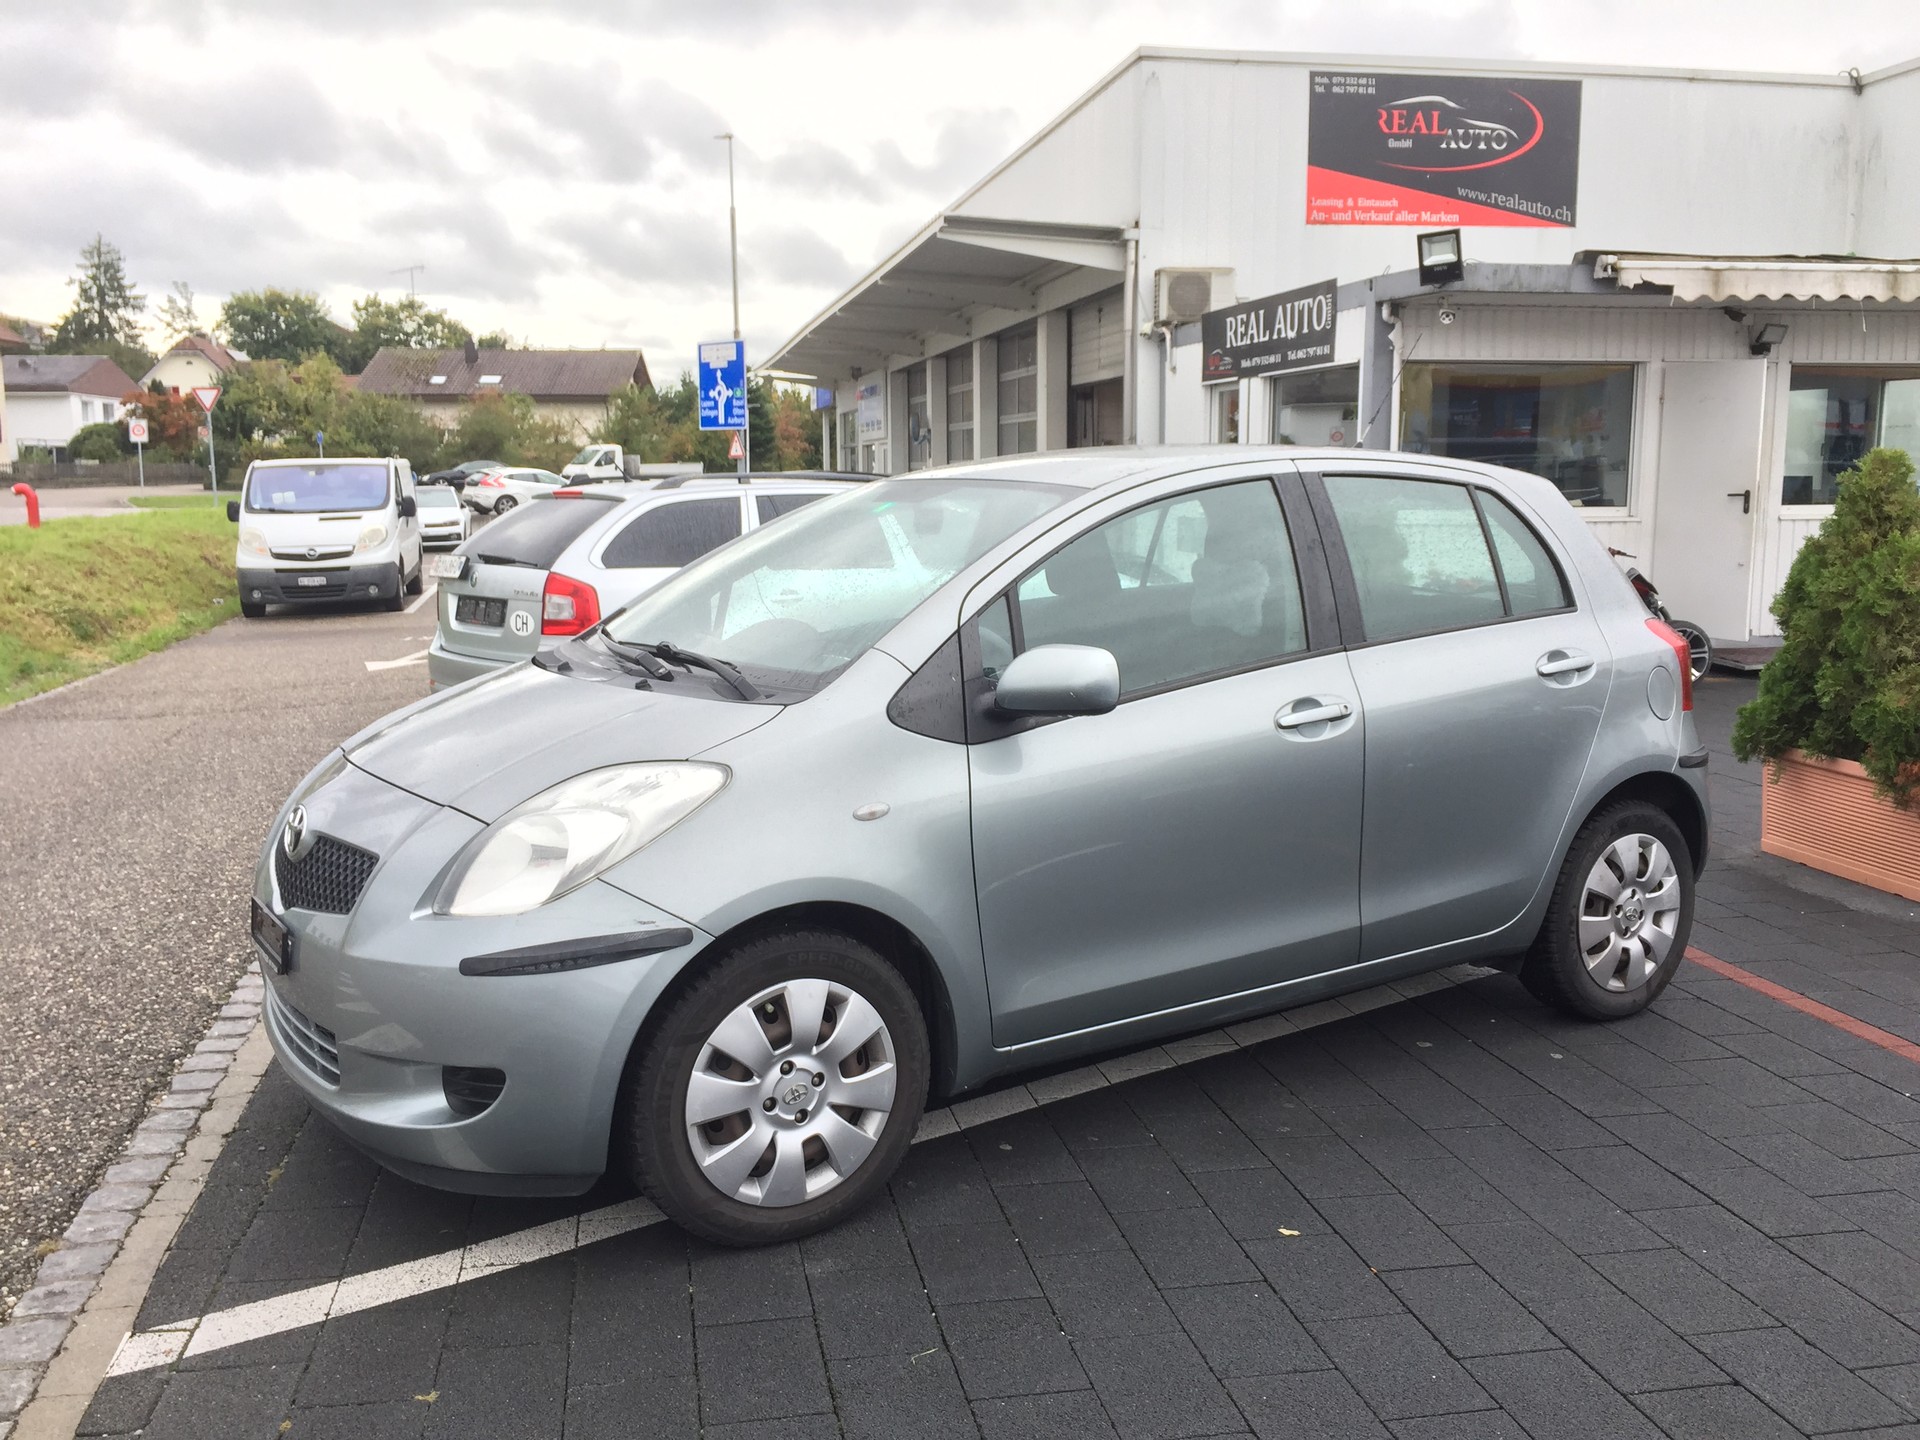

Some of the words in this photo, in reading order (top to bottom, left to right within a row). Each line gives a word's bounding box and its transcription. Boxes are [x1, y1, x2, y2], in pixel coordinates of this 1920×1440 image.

[1378, 108, 1448, 135] REAL
[1440, 129, 1508, 151] AUTO
[1388, 138, 1413, 149] GmbH
[1311, 197, 1344, 208] Leasing
[1346, 198, 1354, 207] &
[1357, 197, 1399, 208] Eintausch
[1457, 187, 1572, 223] www.realauto.ch
[1311, 210, 1329, 221] An-
[1331, 210, 1352, 221] und
[1354, 210, 1394, 222] Verkauf
[1395, 211, 1419, 222] aller
[1421, 211, 1460, 223] Marken
[1225, 310, 1270, 349] REAL
[1272, 294, 1327, 339] AUTO
[1325, 294, 1333, 329] GmbH
[515, 613, 529, 633] CH
